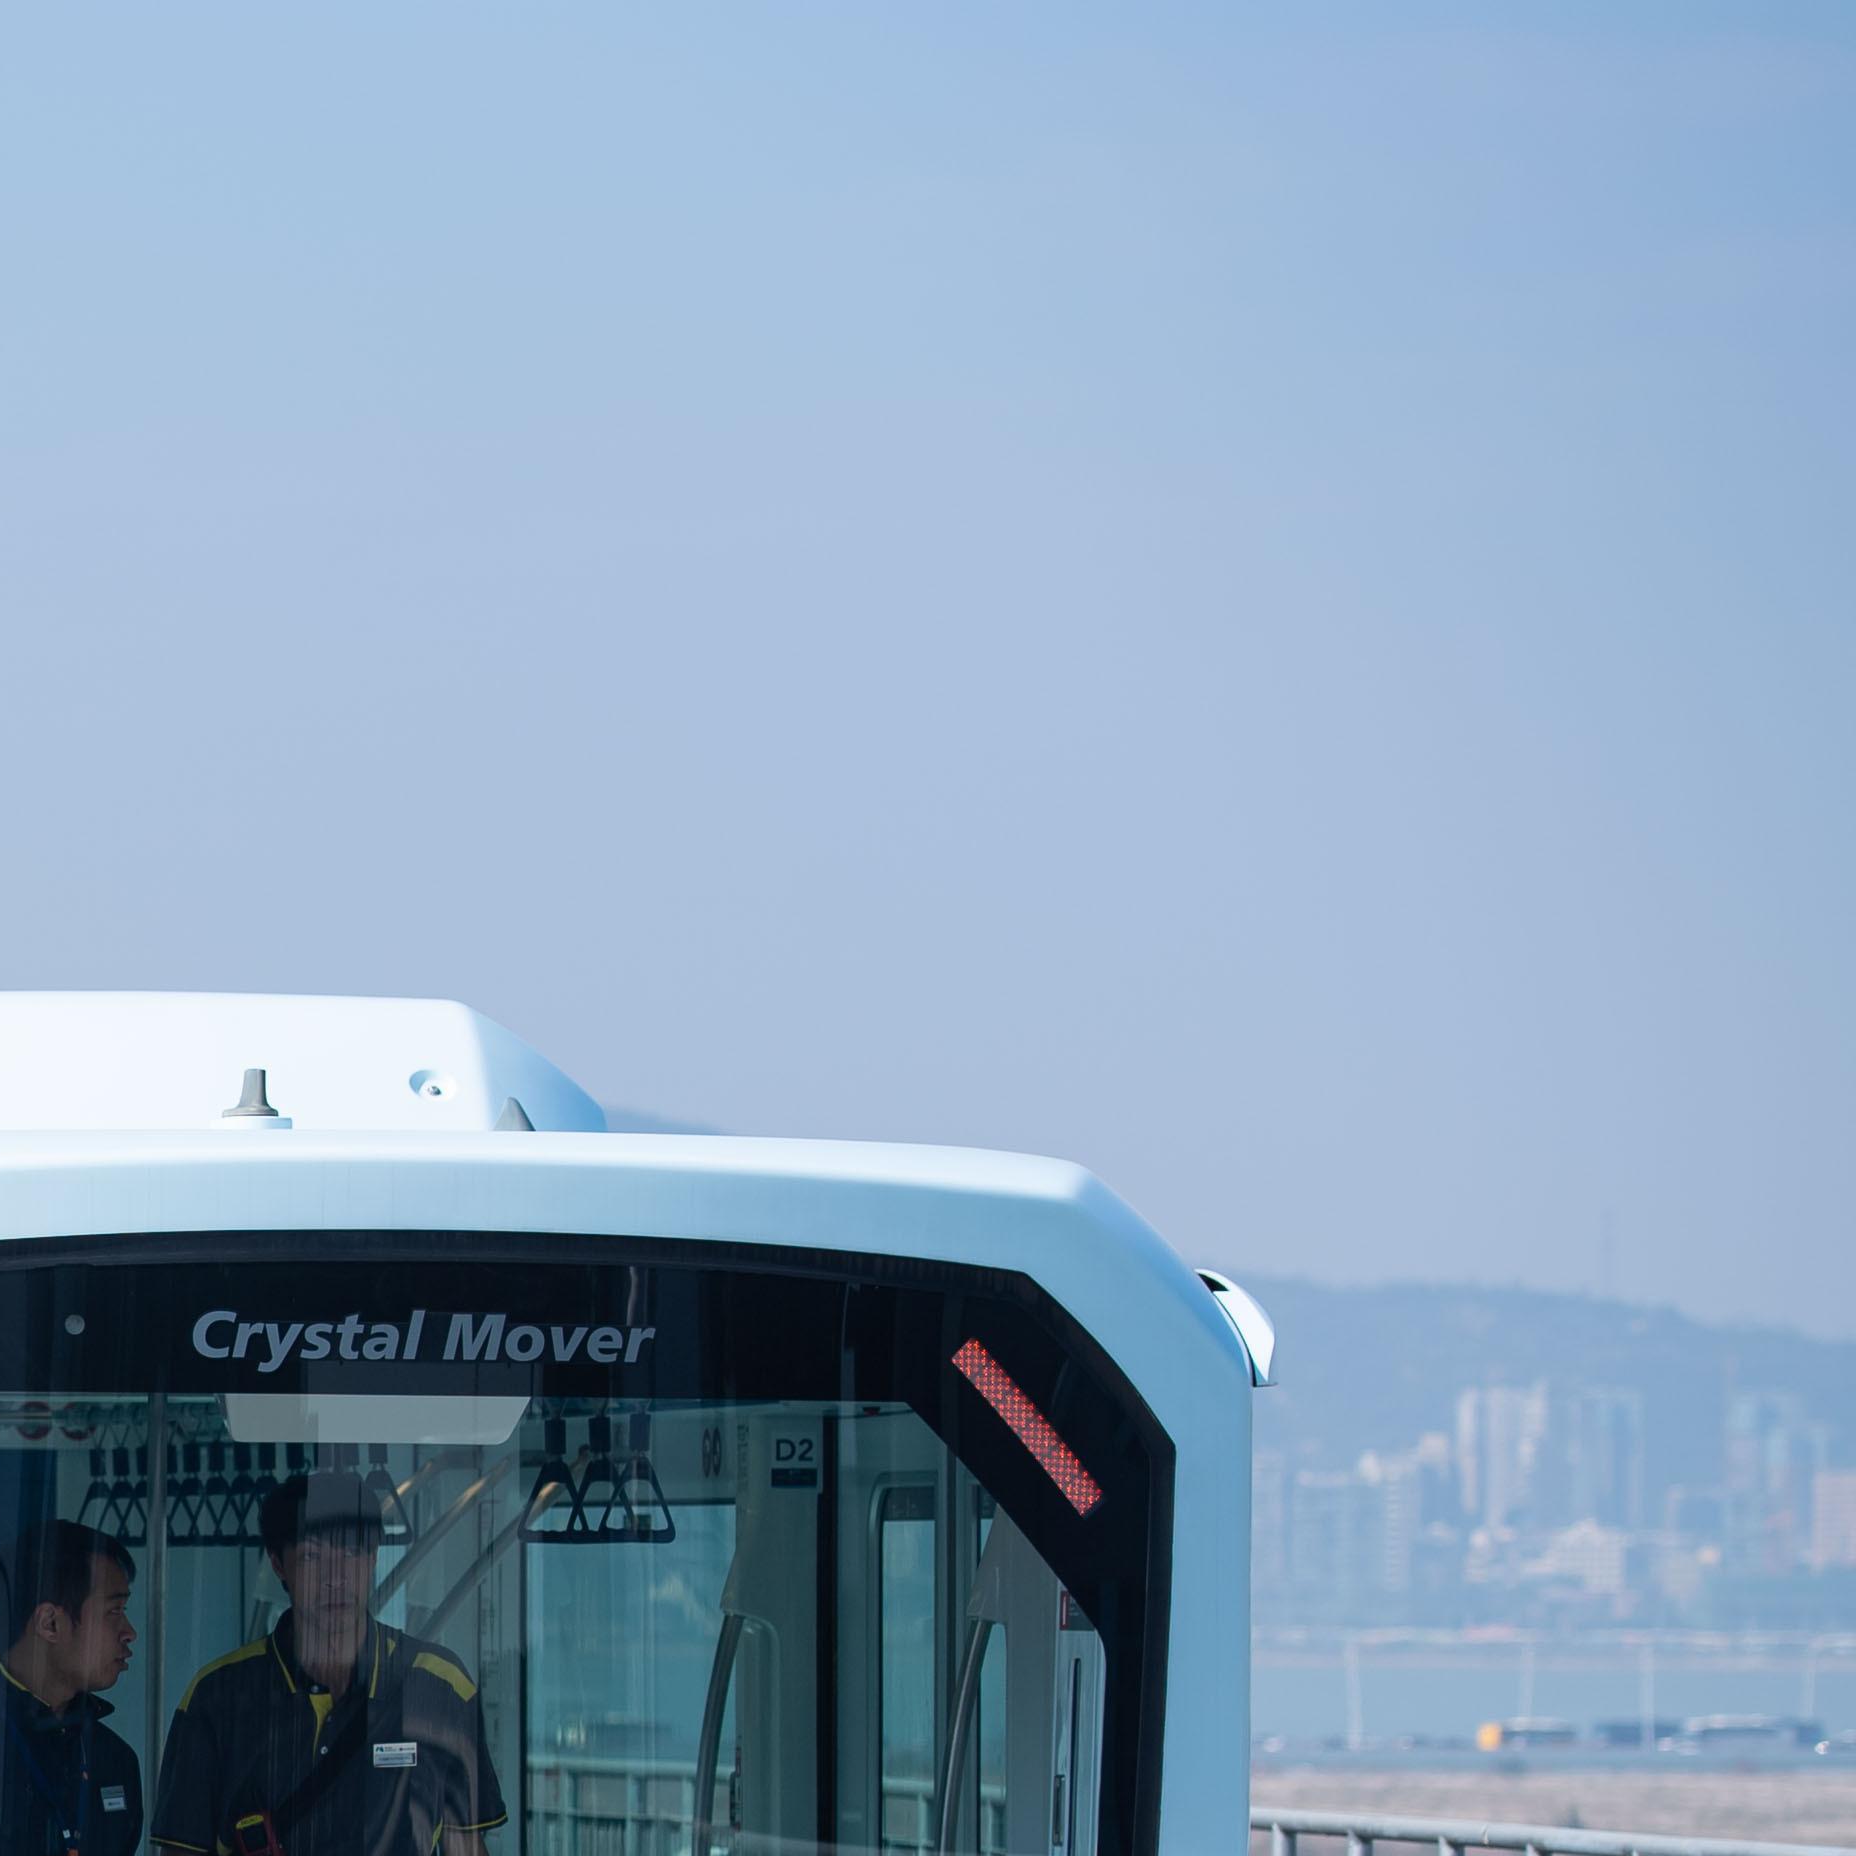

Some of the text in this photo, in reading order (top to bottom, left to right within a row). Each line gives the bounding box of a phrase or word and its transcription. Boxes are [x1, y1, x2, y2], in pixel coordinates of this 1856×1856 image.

[192, 1310, 656, 1373] Crystal Mover
[775, 1438, 814, 1462] D2
